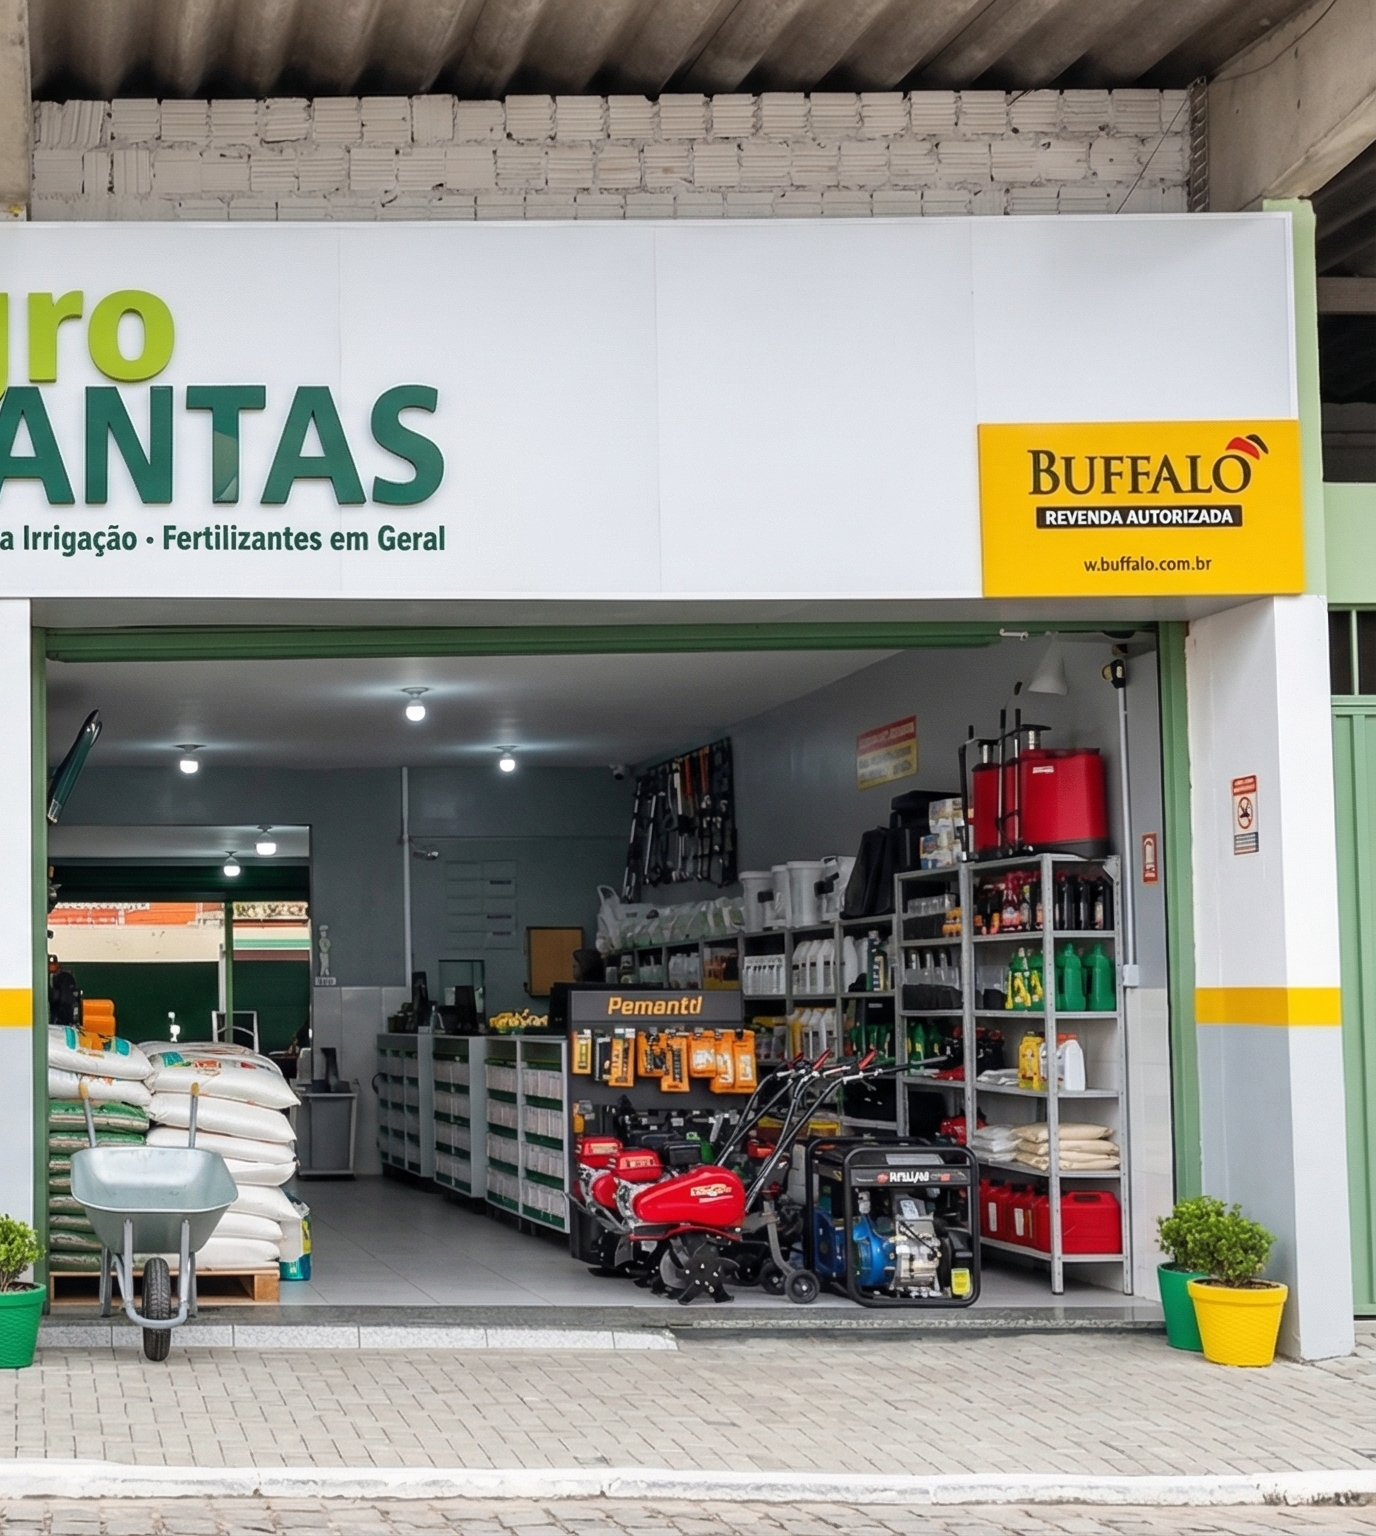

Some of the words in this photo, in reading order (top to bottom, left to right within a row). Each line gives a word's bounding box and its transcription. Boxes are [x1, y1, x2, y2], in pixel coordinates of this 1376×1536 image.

[1028, 449, 1252, 495] BUFFALO
[1045, 509, 1123, 526] REVENDA
[1126, 508, 1233, 525] AUTORIZADA
[23, 524, 138, 558] Irrigação
[163, 524, 323, 551] Fertilizantes
[330, 531, 369, 551] em
[377, 524, 445, 551] Geral
[1083, 555, 1212, 572] w.buffalo.com.br
